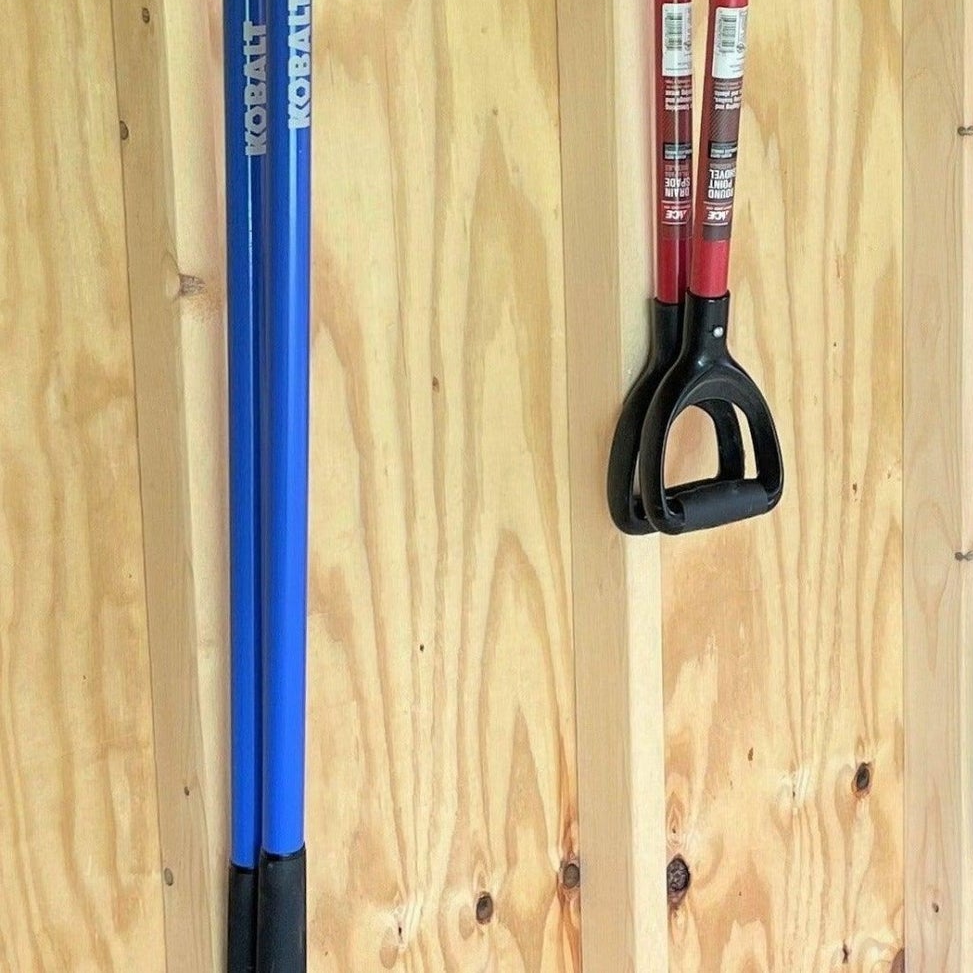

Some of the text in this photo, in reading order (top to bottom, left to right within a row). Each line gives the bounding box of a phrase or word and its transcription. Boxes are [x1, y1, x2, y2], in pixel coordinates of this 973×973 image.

[243, 21, 267, 155] KOBALT
[665, 177, 690, 187] SPADE
[665, 210, 688, 220] ACE
[707, 210, 730, 220] ACE
